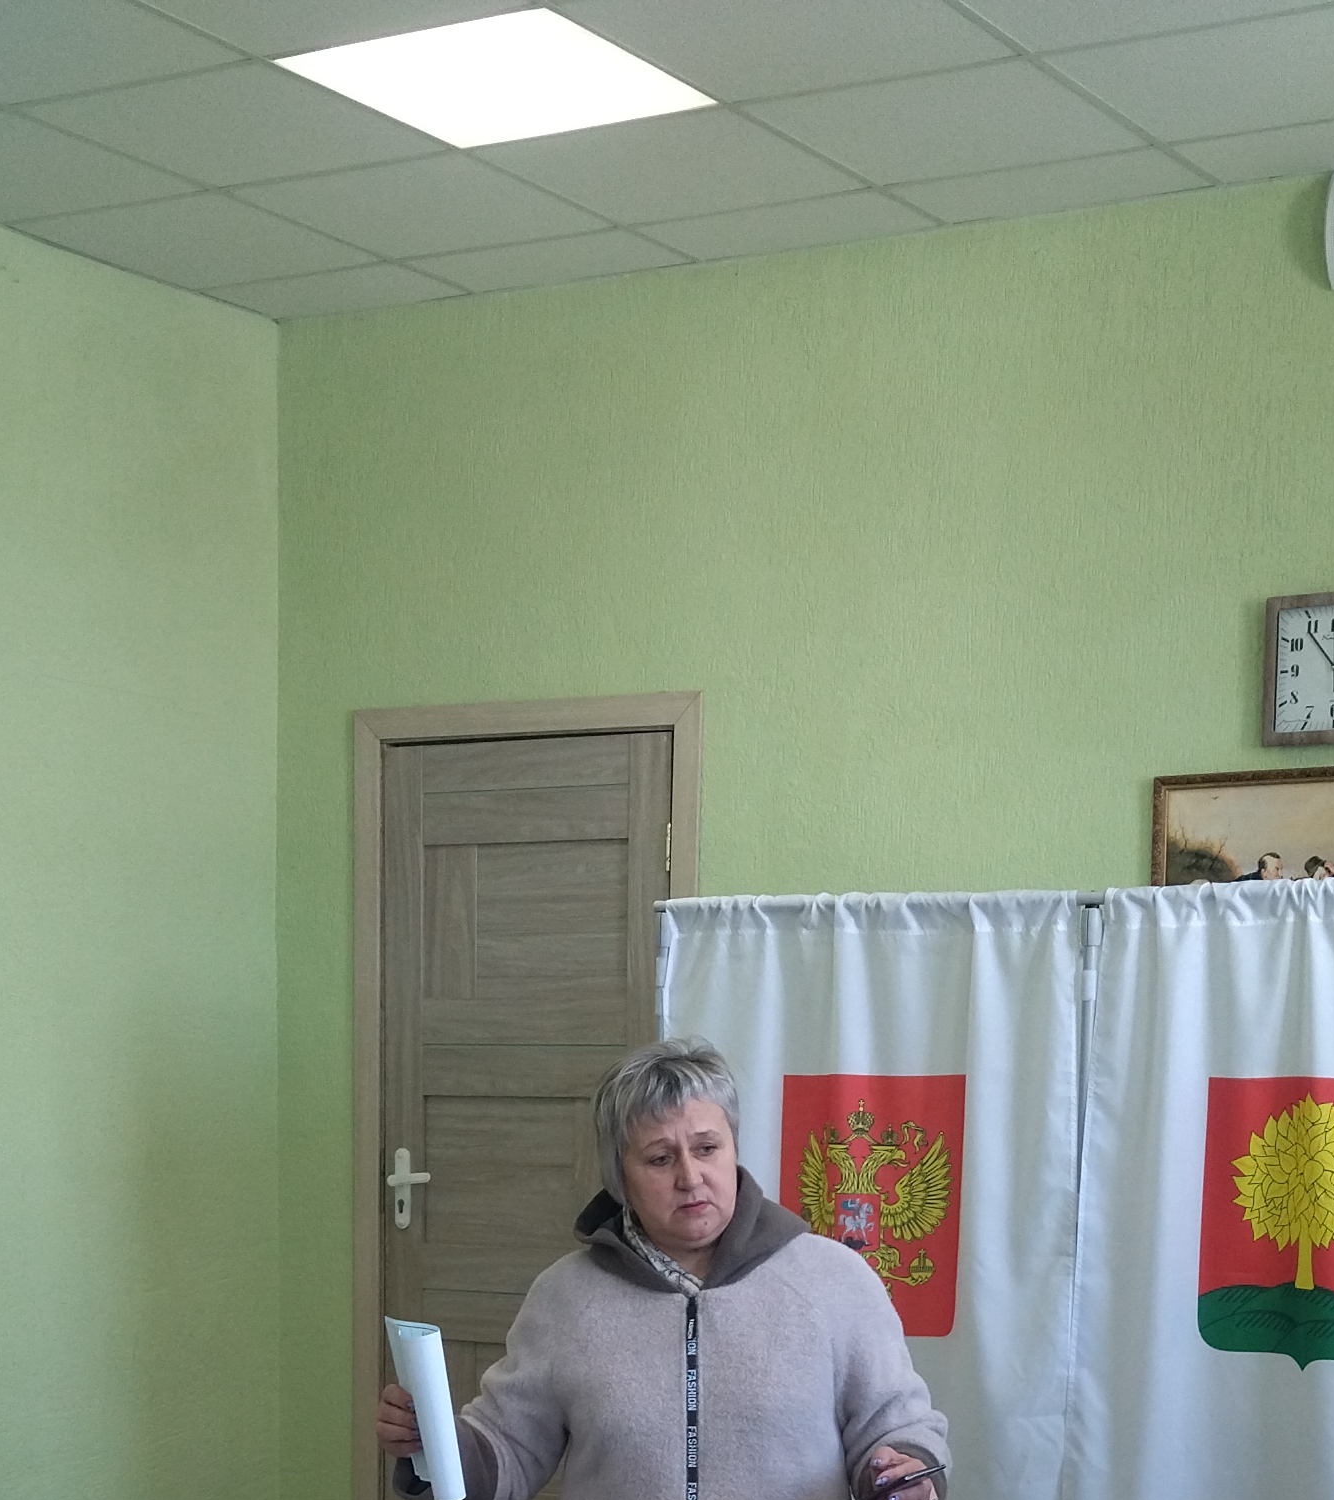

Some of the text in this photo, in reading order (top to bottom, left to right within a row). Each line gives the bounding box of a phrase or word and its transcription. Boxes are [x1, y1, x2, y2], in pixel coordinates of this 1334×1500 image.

[1307, 620, 1318, 633] 11
[1290, 638, 1303, 652] 10
[1291, 664, 1299, 677] 9
[1290, 691, 1298, 704] 8
[1306, 706, 1314, 719] 7
[687, 1370, 696, 1411] FASHION
[687, 1426, 697, 1468] FASHION
